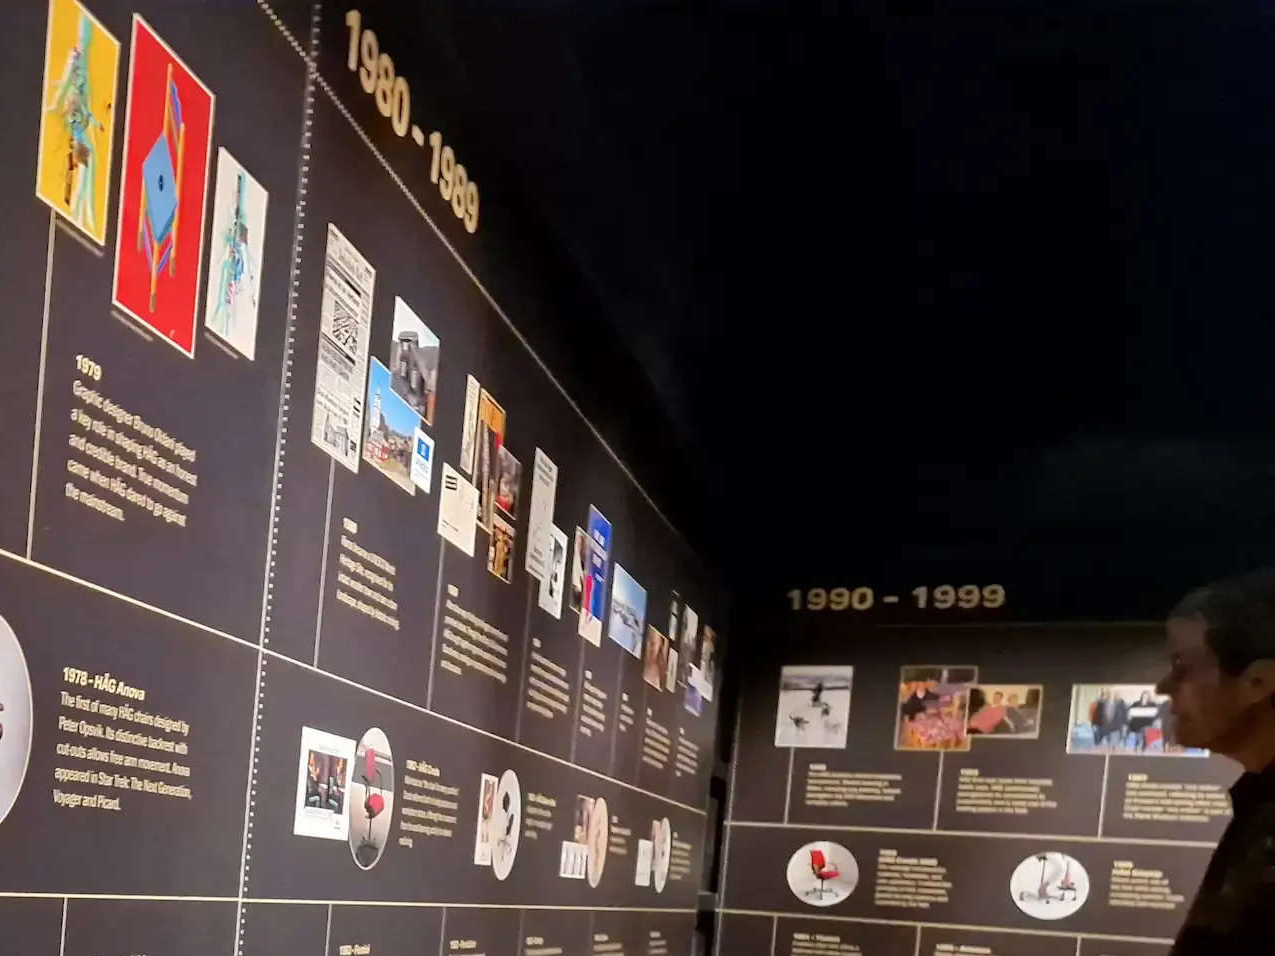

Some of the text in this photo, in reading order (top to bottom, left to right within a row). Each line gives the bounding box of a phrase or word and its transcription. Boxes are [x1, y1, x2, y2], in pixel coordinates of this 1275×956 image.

[345, 9, 410, 137] 1980
[429, 131, 479, 233] 1989
[76, 355, 102, 380] 1979
[787, 587, 874, 611] 1990
[911, 584, 1006, 609] 1999
[63, 667, 145, 700] 1978 HÅG Anova
[61, 692, 118, 720] The first of many
[59, 716, 79, 732] Peter
[55, 768, 113, 785] appeared in Star
[54, 789, 97, 807] Voyager and
